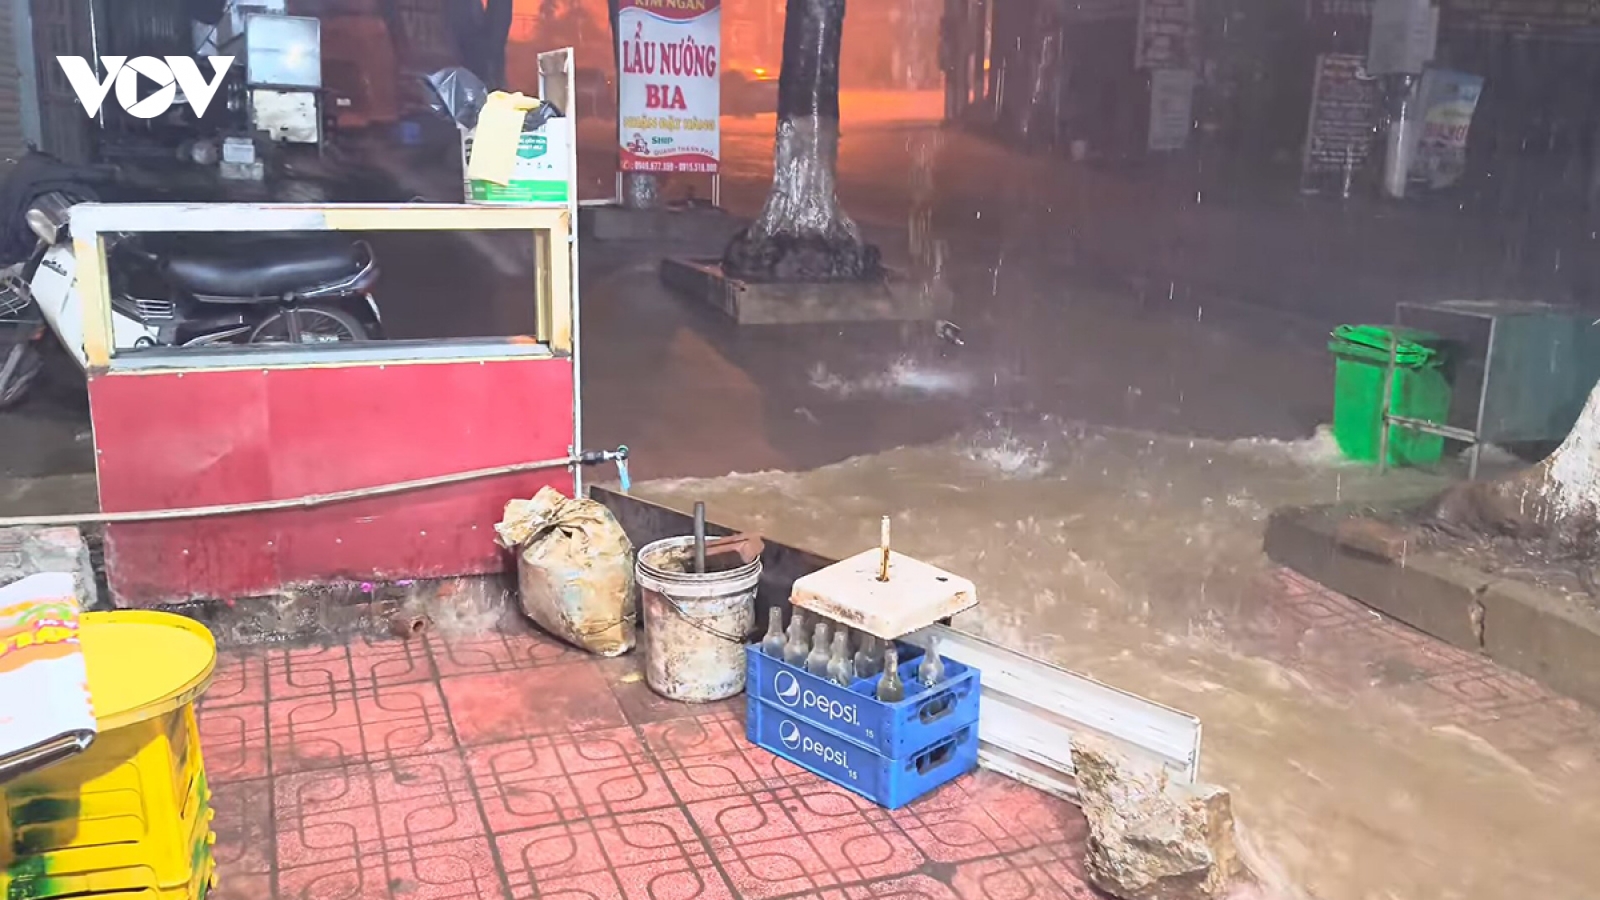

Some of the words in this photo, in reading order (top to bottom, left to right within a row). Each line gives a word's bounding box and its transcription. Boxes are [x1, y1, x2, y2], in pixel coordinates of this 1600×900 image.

[623, 20, 656, 73] LẨU
[660, 35, 716, 77] NƯỚNG
[646, 84, 687, 110] BIA
[651, 136, 673, 145] SHIP
[865, 728, 875, 739] 15
[849, 769, 858, 780] 15
